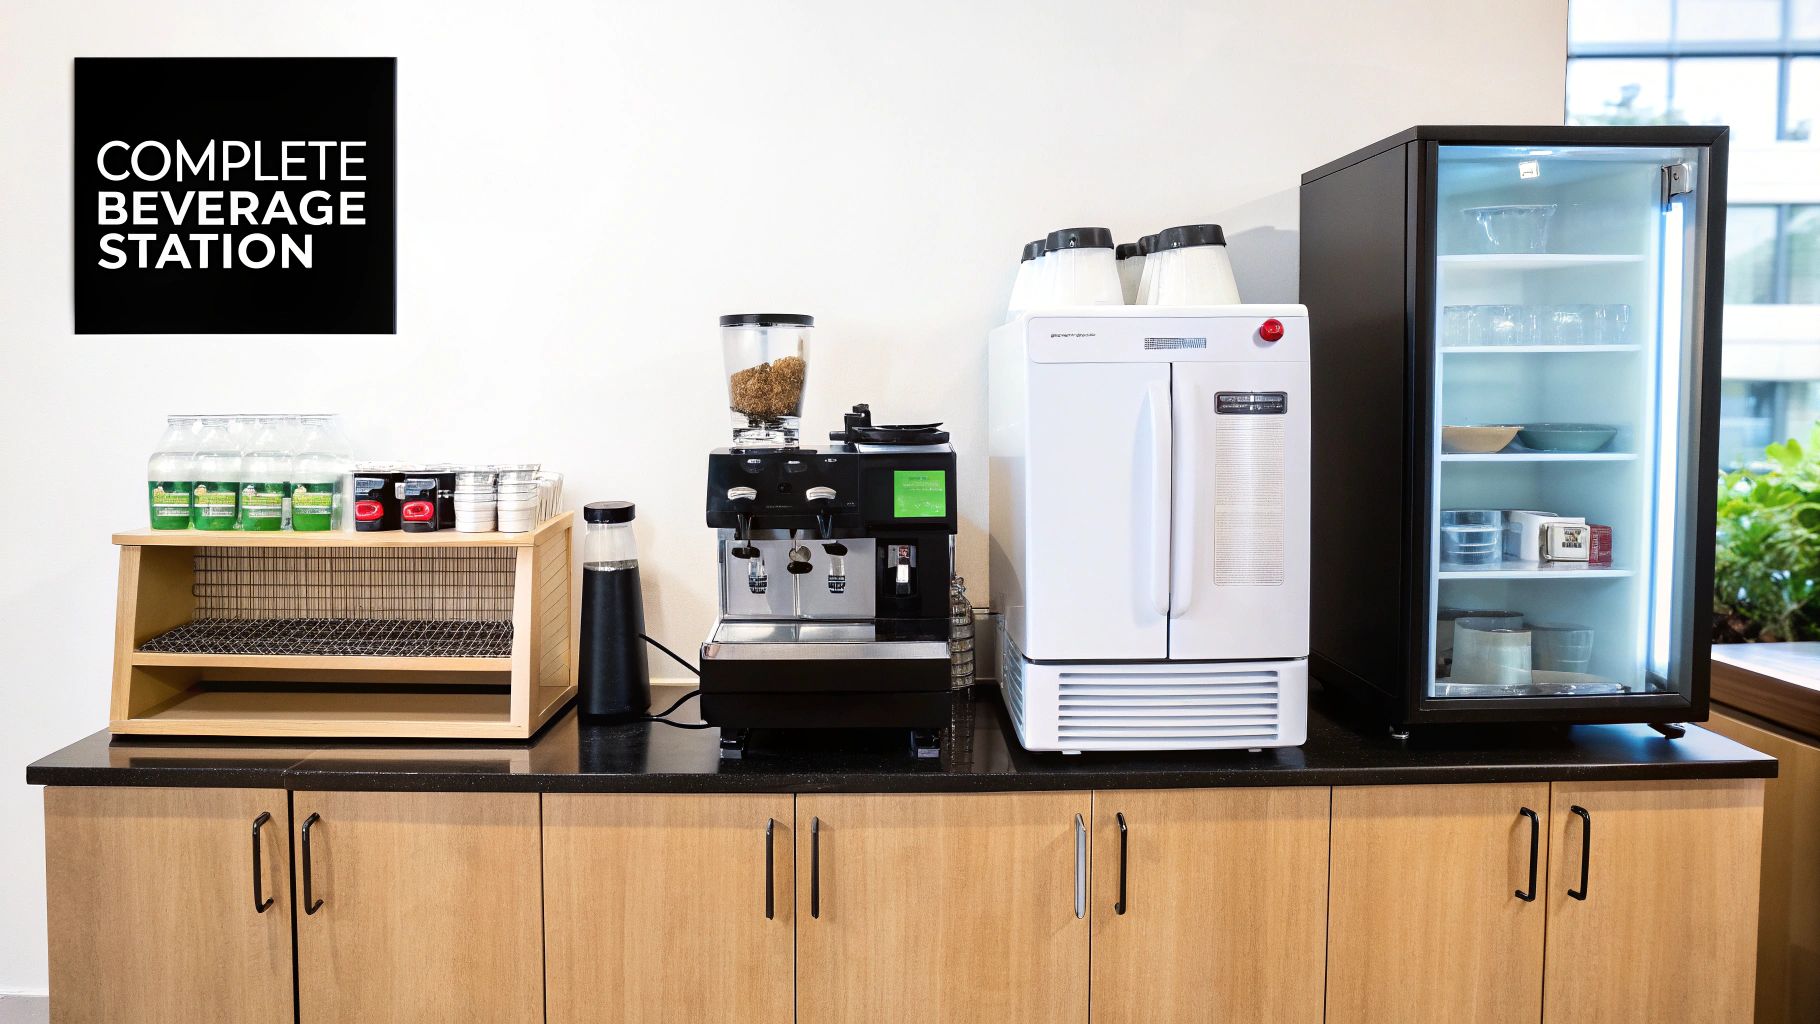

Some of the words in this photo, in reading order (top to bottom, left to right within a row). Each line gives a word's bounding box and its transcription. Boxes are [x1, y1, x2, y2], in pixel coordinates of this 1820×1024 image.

[97, 139, 366, 181] COMPLETE
[98, 191, 365, 225] BEVERAGE
[98, 233, 312, 269] STATION
